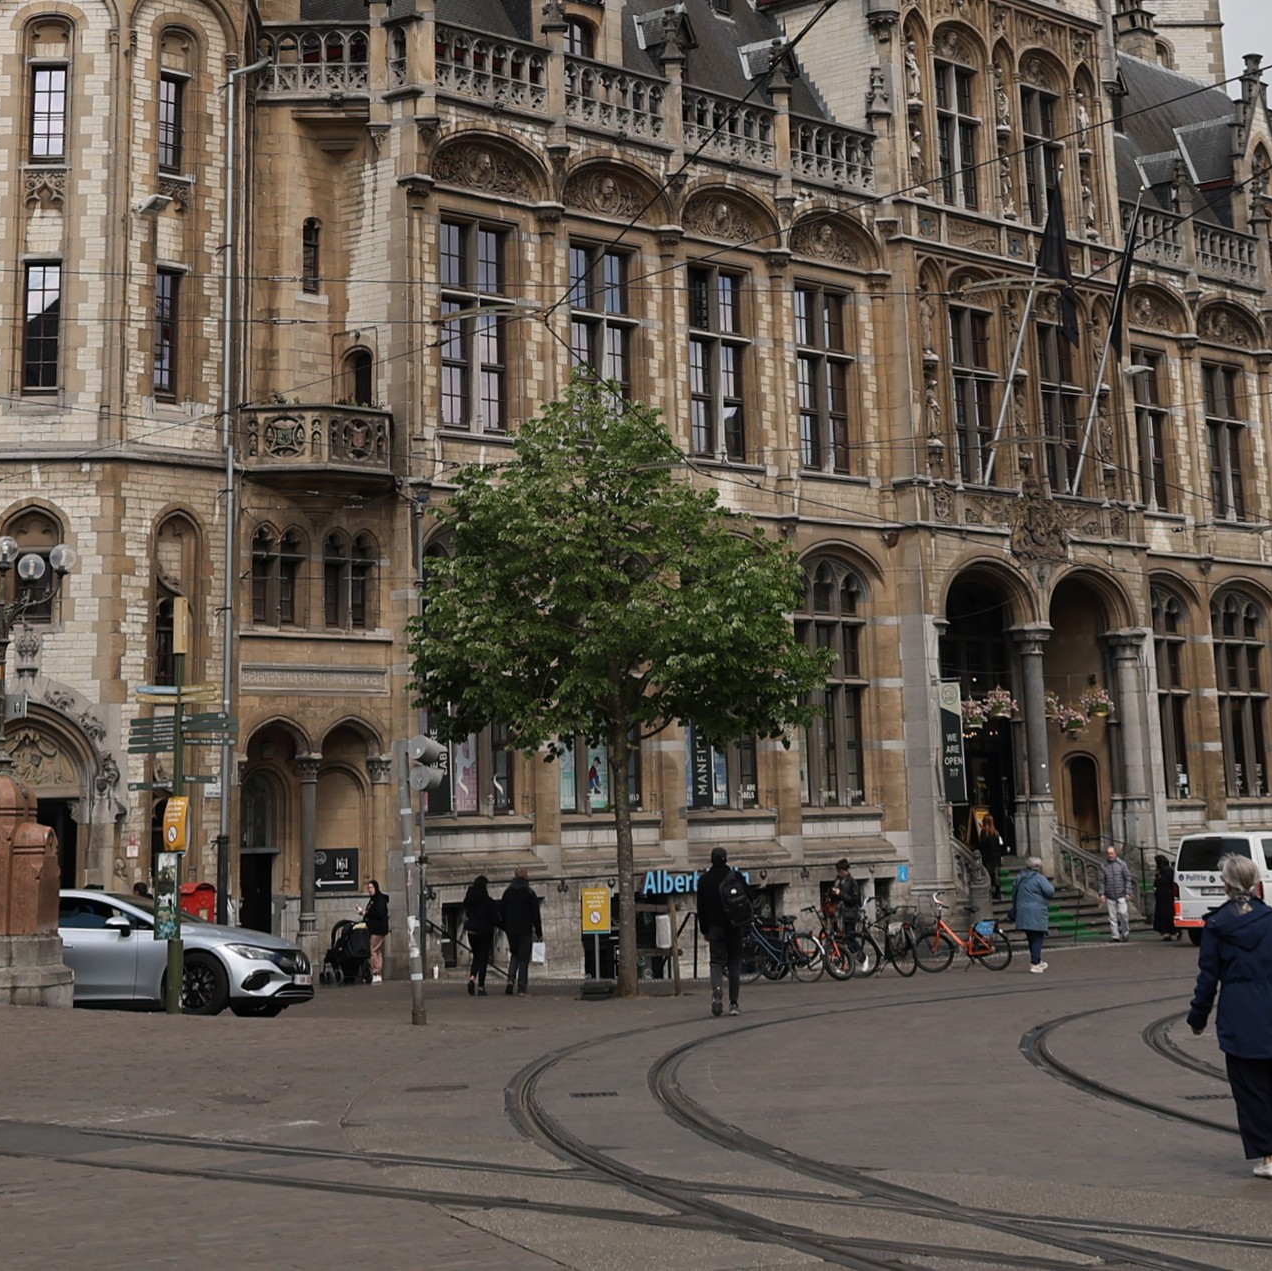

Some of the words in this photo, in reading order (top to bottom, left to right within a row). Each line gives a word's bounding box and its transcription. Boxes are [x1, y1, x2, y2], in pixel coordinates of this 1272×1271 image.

[946, 733, 957, 742] WE
[946, 744, 960, 754] ARE
[944, 756, 963, 766] OPEN
[643, 870, 700, 894] Albert
